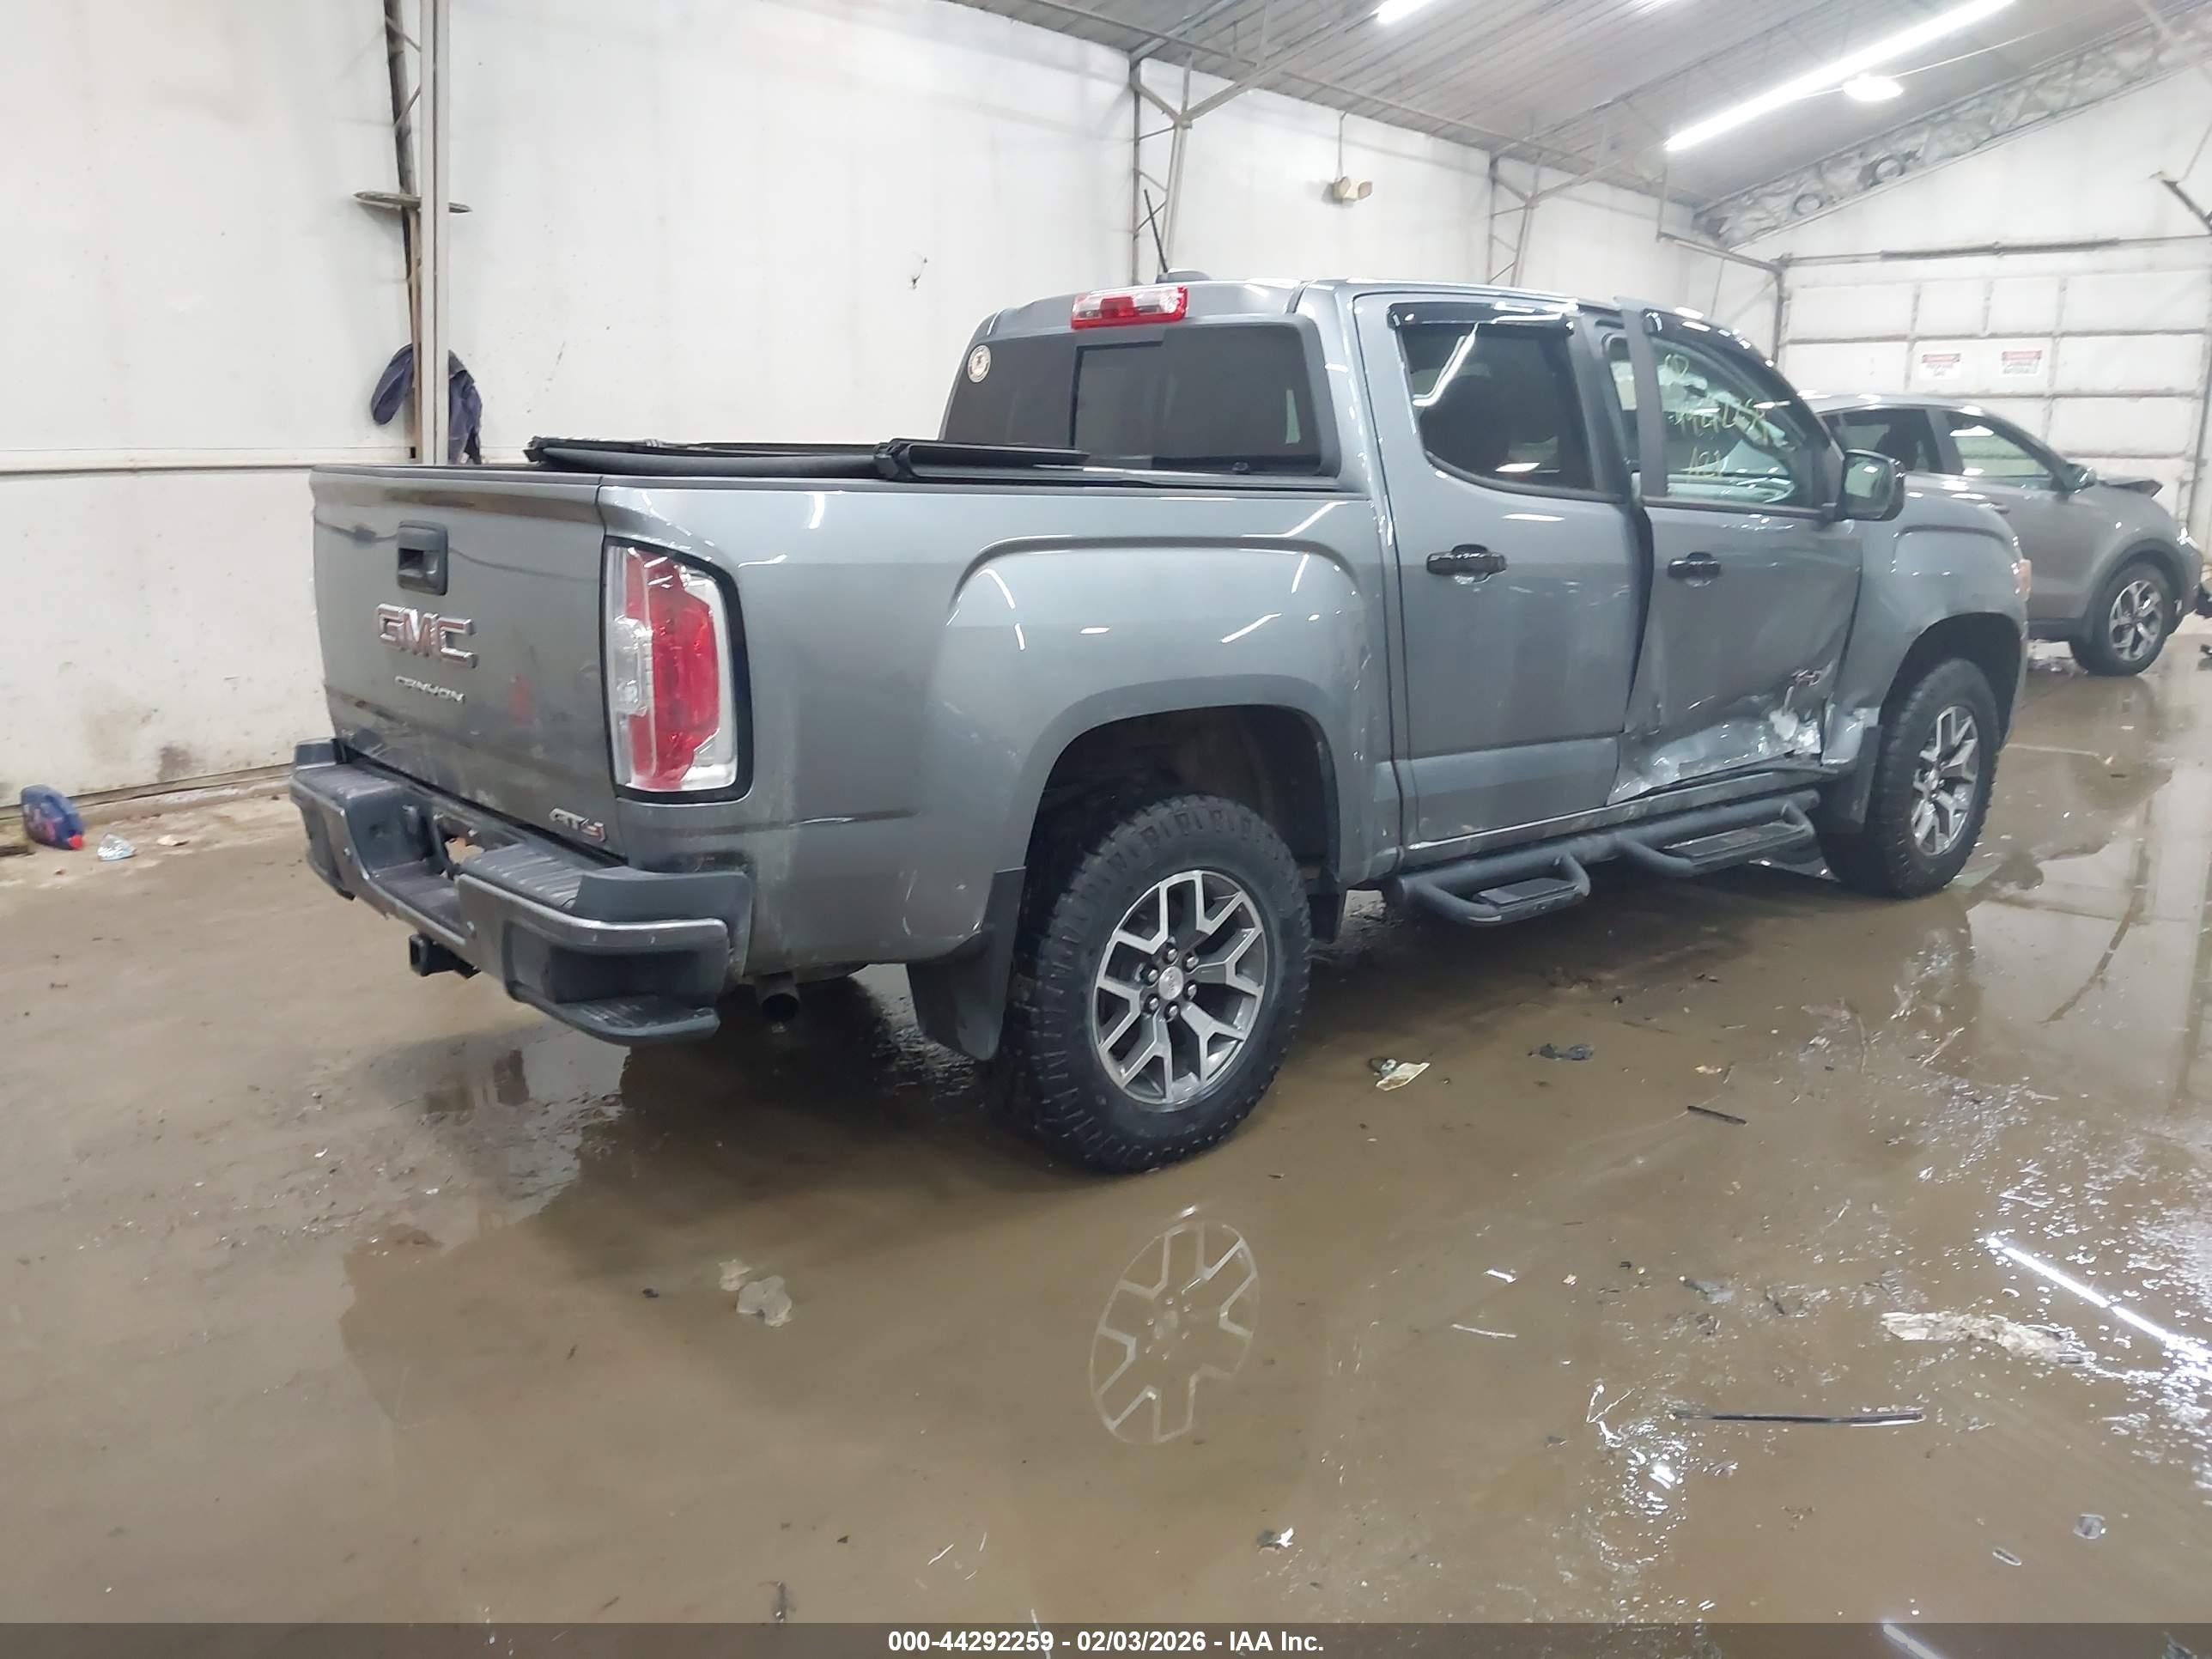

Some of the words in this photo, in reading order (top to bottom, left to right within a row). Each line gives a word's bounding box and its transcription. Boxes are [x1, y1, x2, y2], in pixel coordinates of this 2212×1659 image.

[376, 603, 477, 668] GMC
[394, 675, 465, 703] CANYON
[550, 807, 606, 843] AT4
